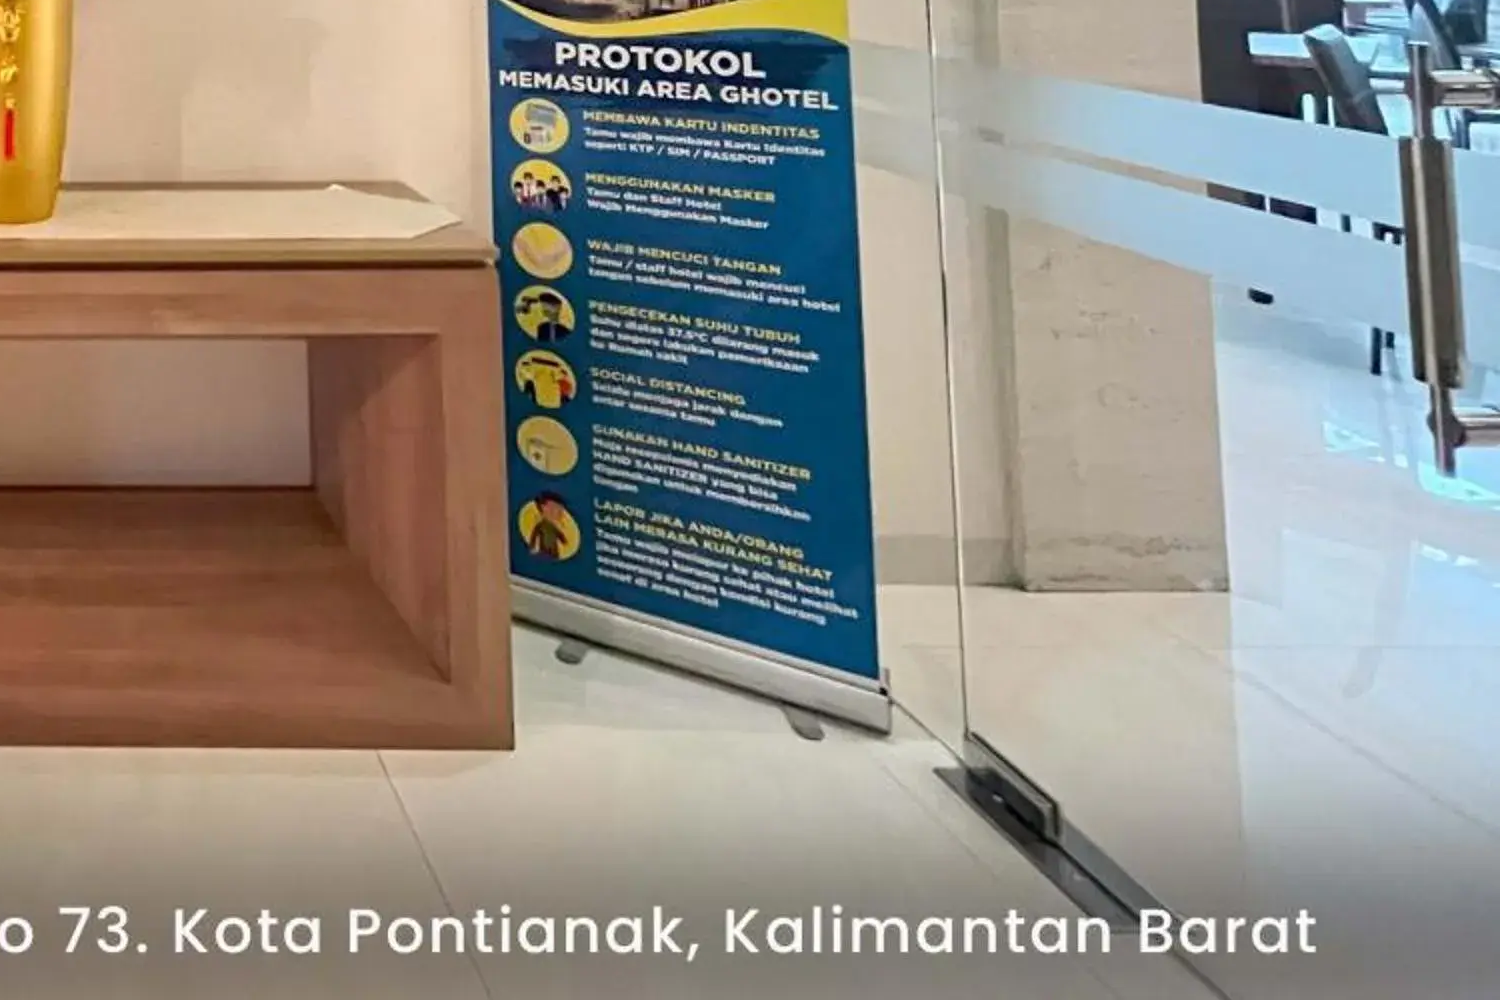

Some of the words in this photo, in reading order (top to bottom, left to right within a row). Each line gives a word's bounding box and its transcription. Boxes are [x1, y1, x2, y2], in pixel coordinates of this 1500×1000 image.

[554, 41, 766, 78] PROTOKOL
[499, 70, 629, 95] MEMASUKI
[637, 79, 710, 101] AREA
[719, 84, 838, 110] GHOTEL
[582, 109, 660, 126] MEMBAWA
[664, 116, 717, 131] KARTU
[721, 120, 820, 140] INDENTITAS
[584, 127, 616, 138] Tamu
[723, 139, 760, 151] Kartu
[629, 143, 654, 154] KTP
[667, 146, 690, 157] SIM
[703, 149, 775, 165] PASSPORT
[585, 172, 704, 195] MENGGUNAKAN
[707, 185, 775, 202] MASKER
[587, 187, 620, 199] Tamu
[623, 191, 647, 202] dan
[649, 194, 682, 206] Staff
[685, 198, 721, 210] Hotel
[719, 215, 769, 230] Masker
[587, 239, 634, 255] WAJIB
[638, 246, 708, 265] MENCUCI
[712, 256, 781, 276] TANGAN
[588, 255, 622, 268] Tamu
[635, 261, 666, 274] staff
[668, 266, 702, 279] hotel
[802, 298, 840, 313] hotel
[588, 300, 691, 326] PENGECEKAN
[695, 317, 738, 334] SUHU
[743, 325, 800, 344] TUBUH
[589, 366, 645, 386] SOCIAL
[649, 377, 746, 406] DISTANCING
[591, 422, 669, 449] GUNAKAN
[672, 440, 717, 460] HAND
[722, 450, 811, 480] SANITIZER
[592, 449, 631, 467] HAND
[635, 459, 706, 484] SANITIZER
[650, 511, 683, 530] JIKA
[594, 511, 629, 530] LAIN
[632, 521, 698, 548] MERASA
[703, 539, 772, 567] KURANG
[777, 557, 833, 582] SEHAT
